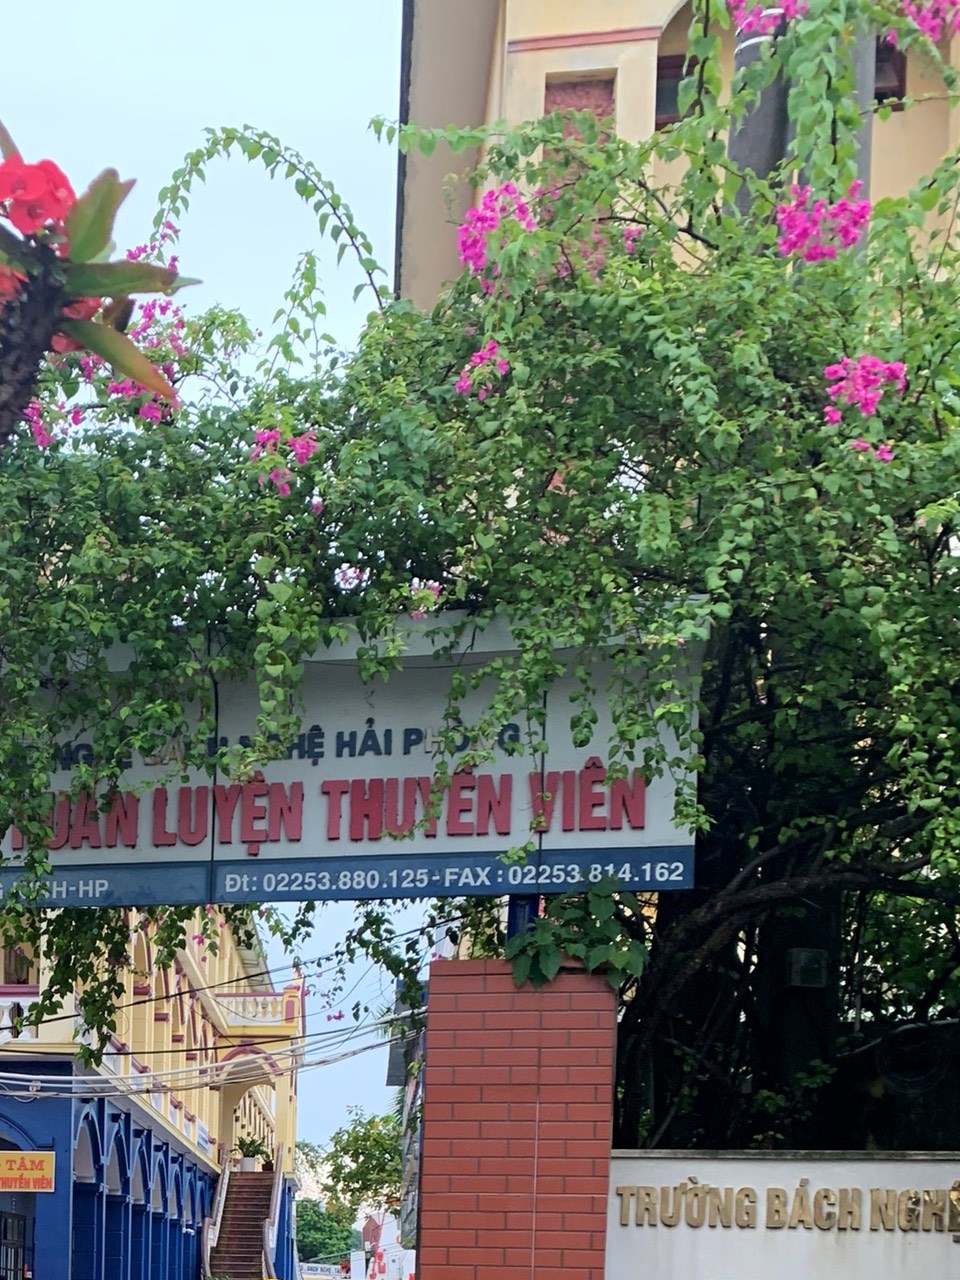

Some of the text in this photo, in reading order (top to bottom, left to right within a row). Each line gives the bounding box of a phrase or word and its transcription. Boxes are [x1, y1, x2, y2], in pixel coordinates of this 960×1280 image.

[335, 717, 392, 758] HẢI
[152, 769, 304, 857] LUYỆN
[528, 755, 647, 834] VIÊN
[6, 1156, 45, 1171] TÂM
[33, 1174, 52, 1189] VIÊN
[616, 1175, 758, 1228] TRƯỜNG
[765, 1178, 862, 1231] BÁCH
